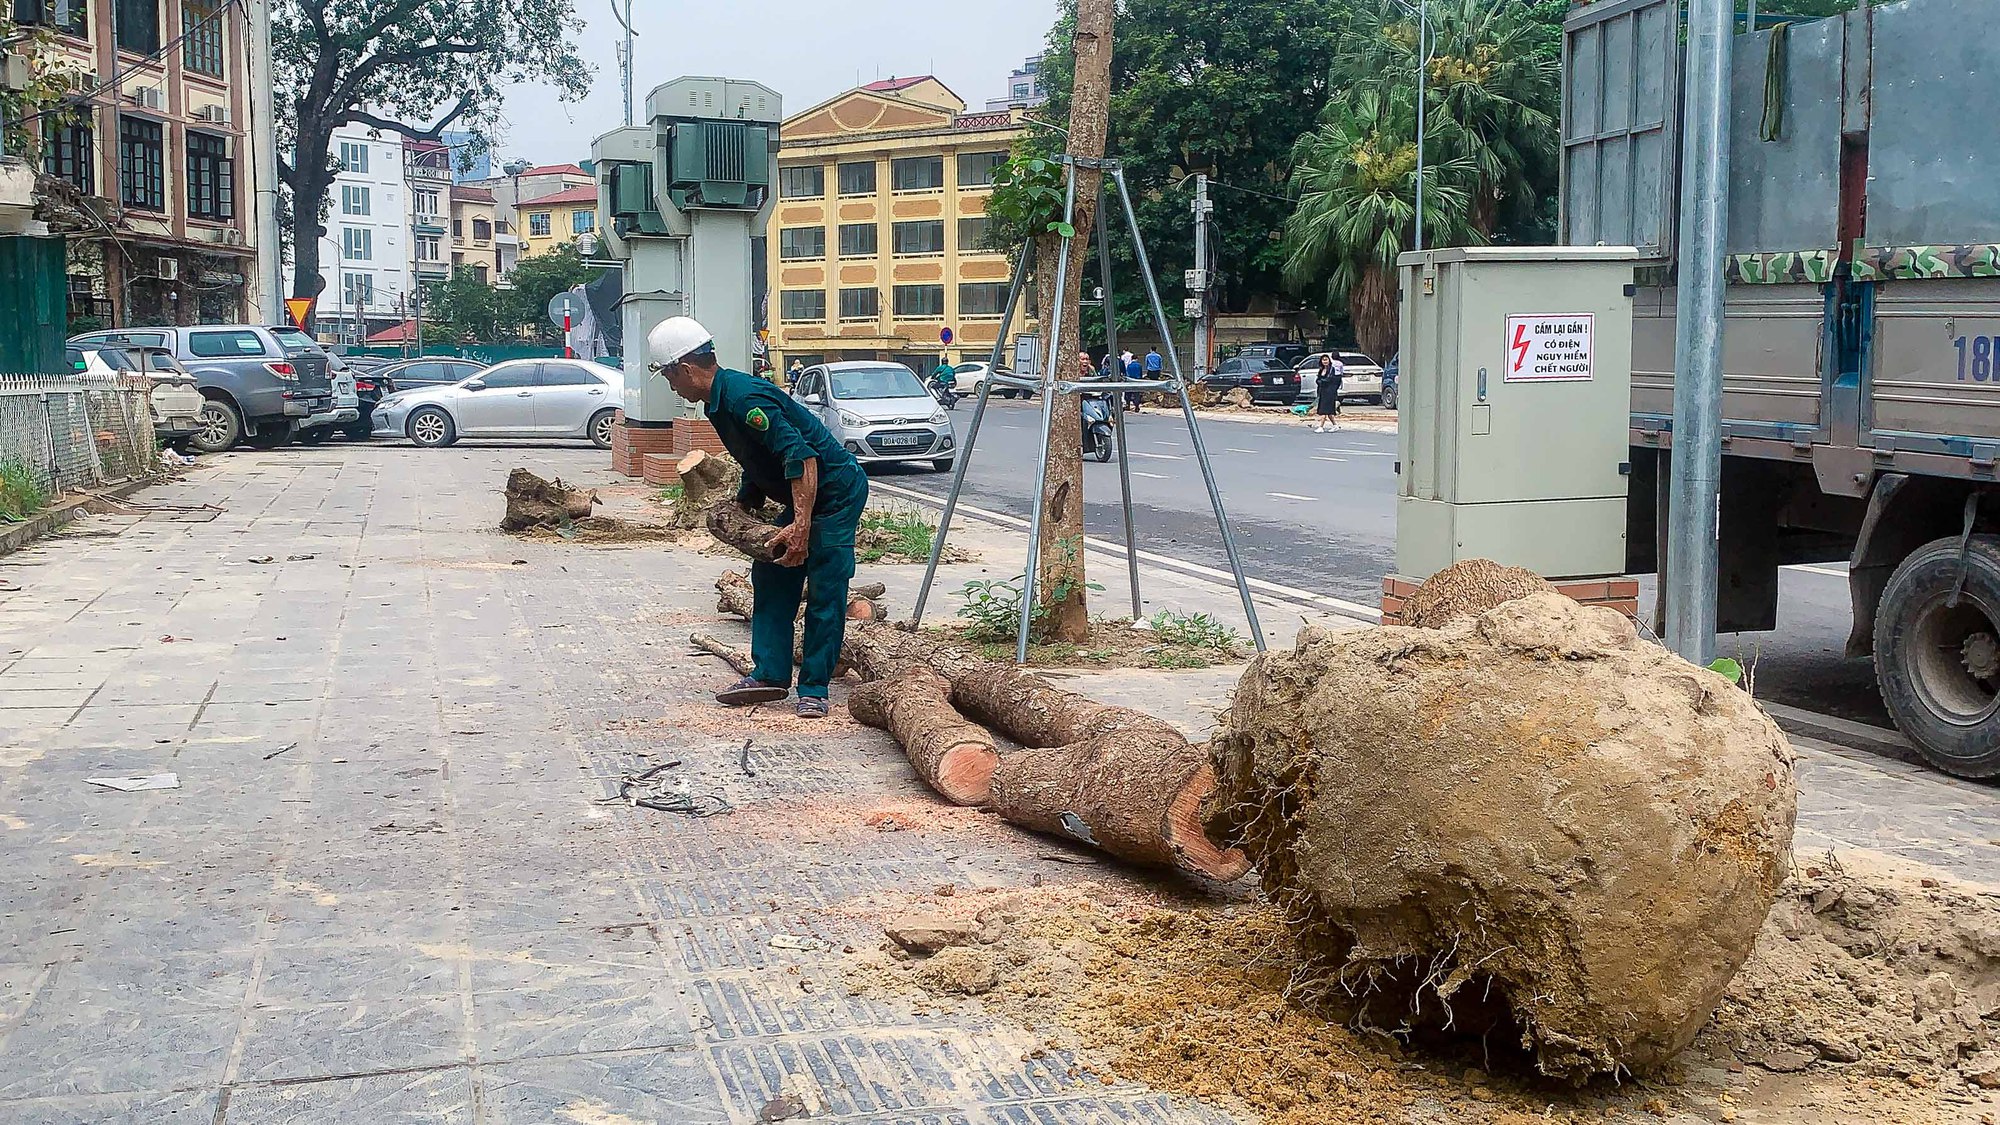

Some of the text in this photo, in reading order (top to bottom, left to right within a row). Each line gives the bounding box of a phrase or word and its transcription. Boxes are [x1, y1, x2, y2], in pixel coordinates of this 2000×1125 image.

[1534, 321, 1552, 334] CẤM
[1553, 324, 1565, 336] LẠI
[1544, 338, 1580, 350] CÓ ĐIỆN
[1536, 353, 1562, 361] NGUY
[1534, 362, 1588, 373] CHẾT NGƯỜI
